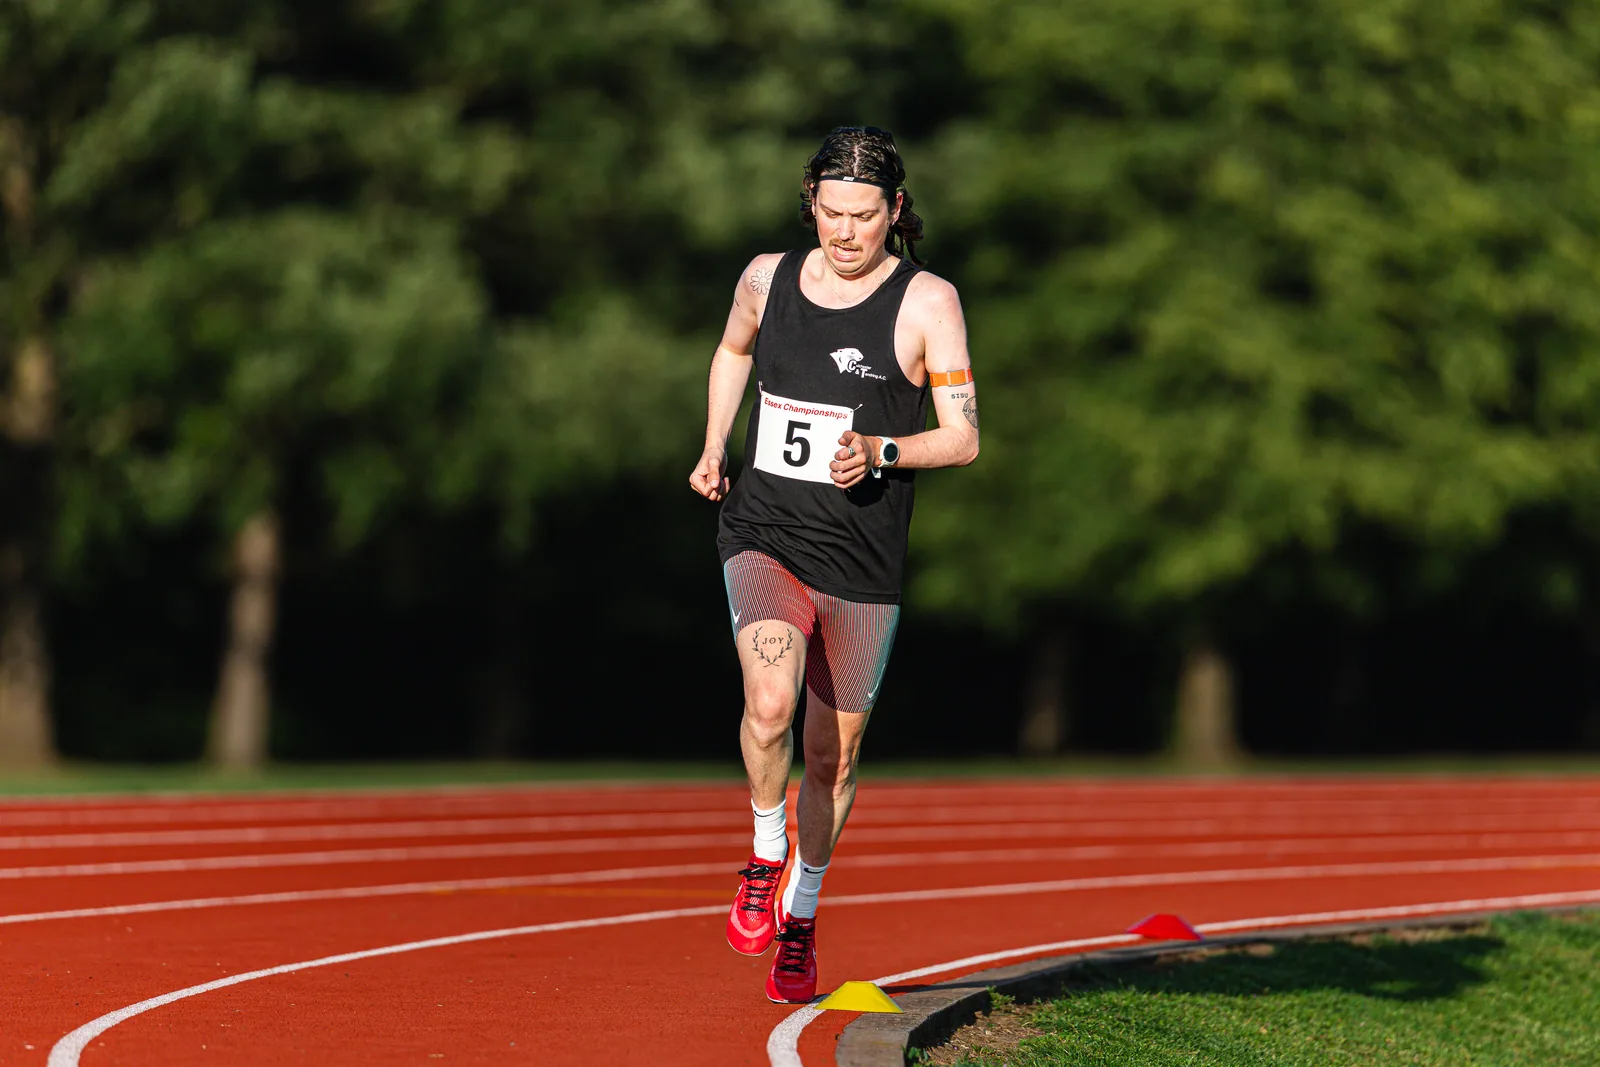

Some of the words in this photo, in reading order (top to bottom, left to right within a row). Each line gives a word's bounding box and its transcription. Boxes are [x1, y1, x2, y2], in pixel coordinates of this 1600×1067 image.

[764, 397, 782, 410] Essex
[783, 403, 848, 420] Championships
[783, 420, 811, 467] 5
[762, 637, 784, 645] JOY
